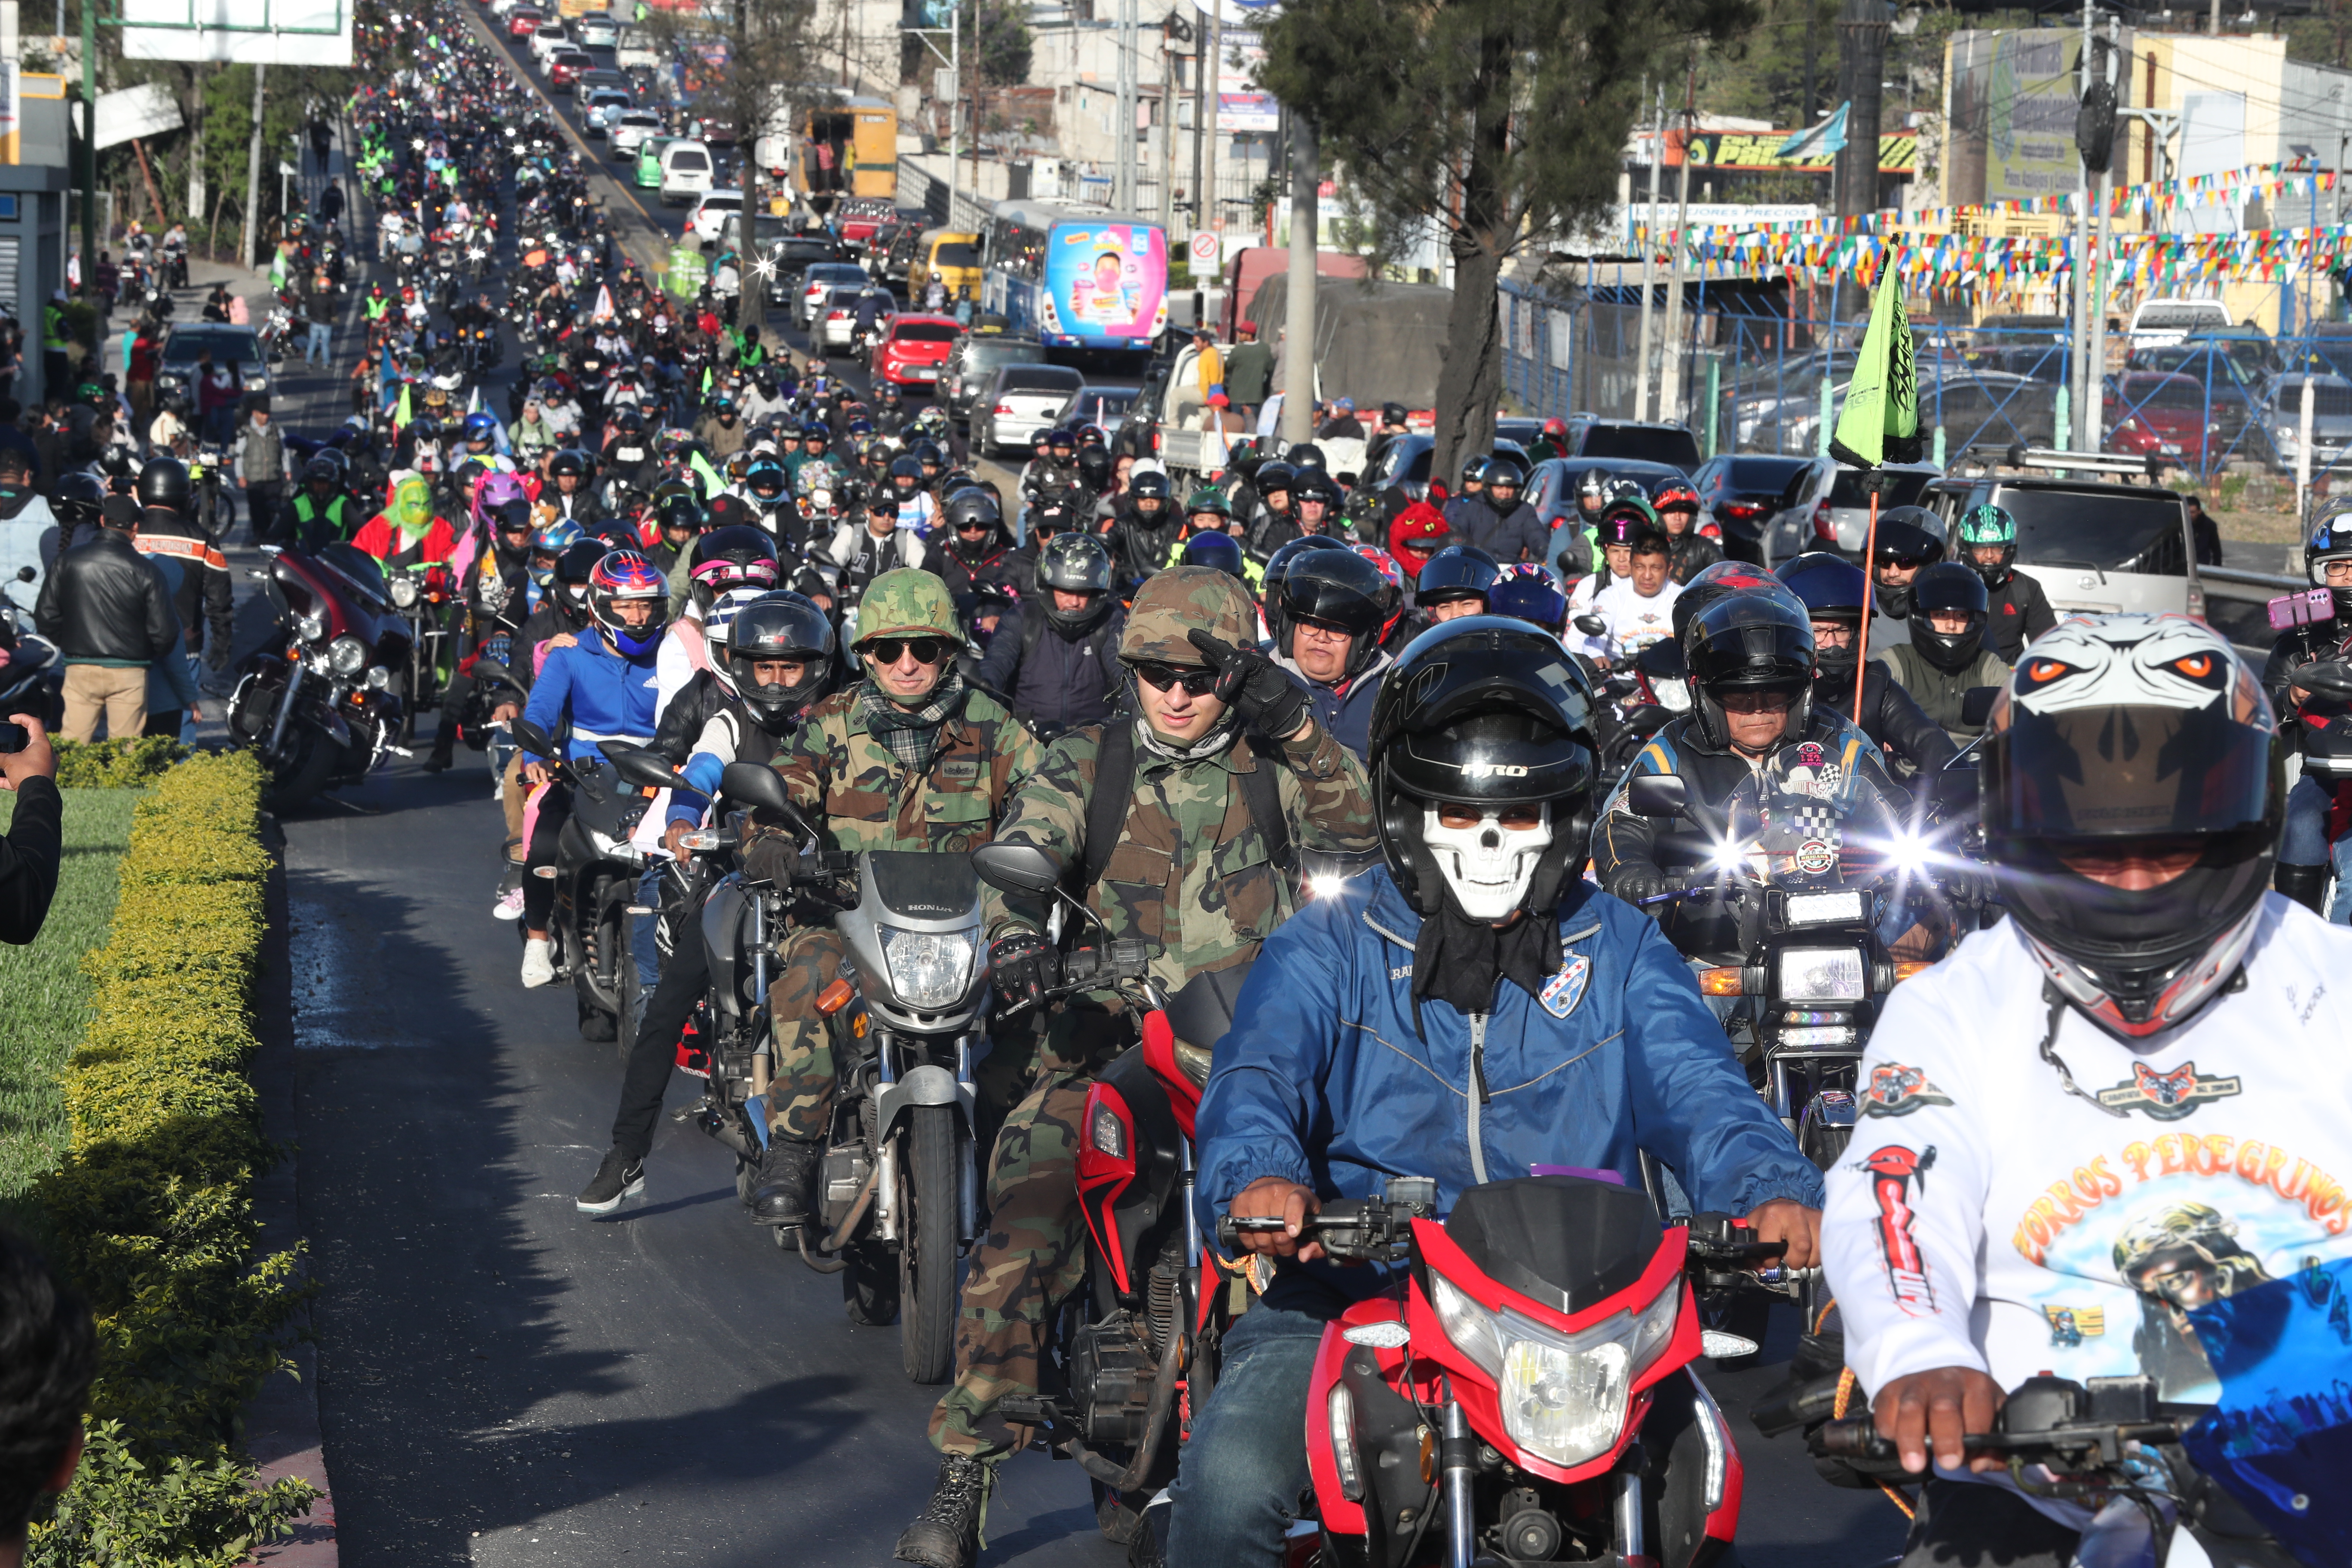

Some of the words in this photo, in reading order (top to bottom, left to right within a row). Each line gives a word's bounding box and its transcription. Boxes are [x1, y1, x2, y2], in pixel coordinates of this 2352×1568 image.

[132, 537, 193, 554] LEY-DAVIDSON
[1460, 764, 1529, 779] HRO
[908, 904, 952, 913] HONDA
[2012, 1154, 2122, 1267] ZORROS
[2122, 1132, 2352, 1236] PEREGRINOS
